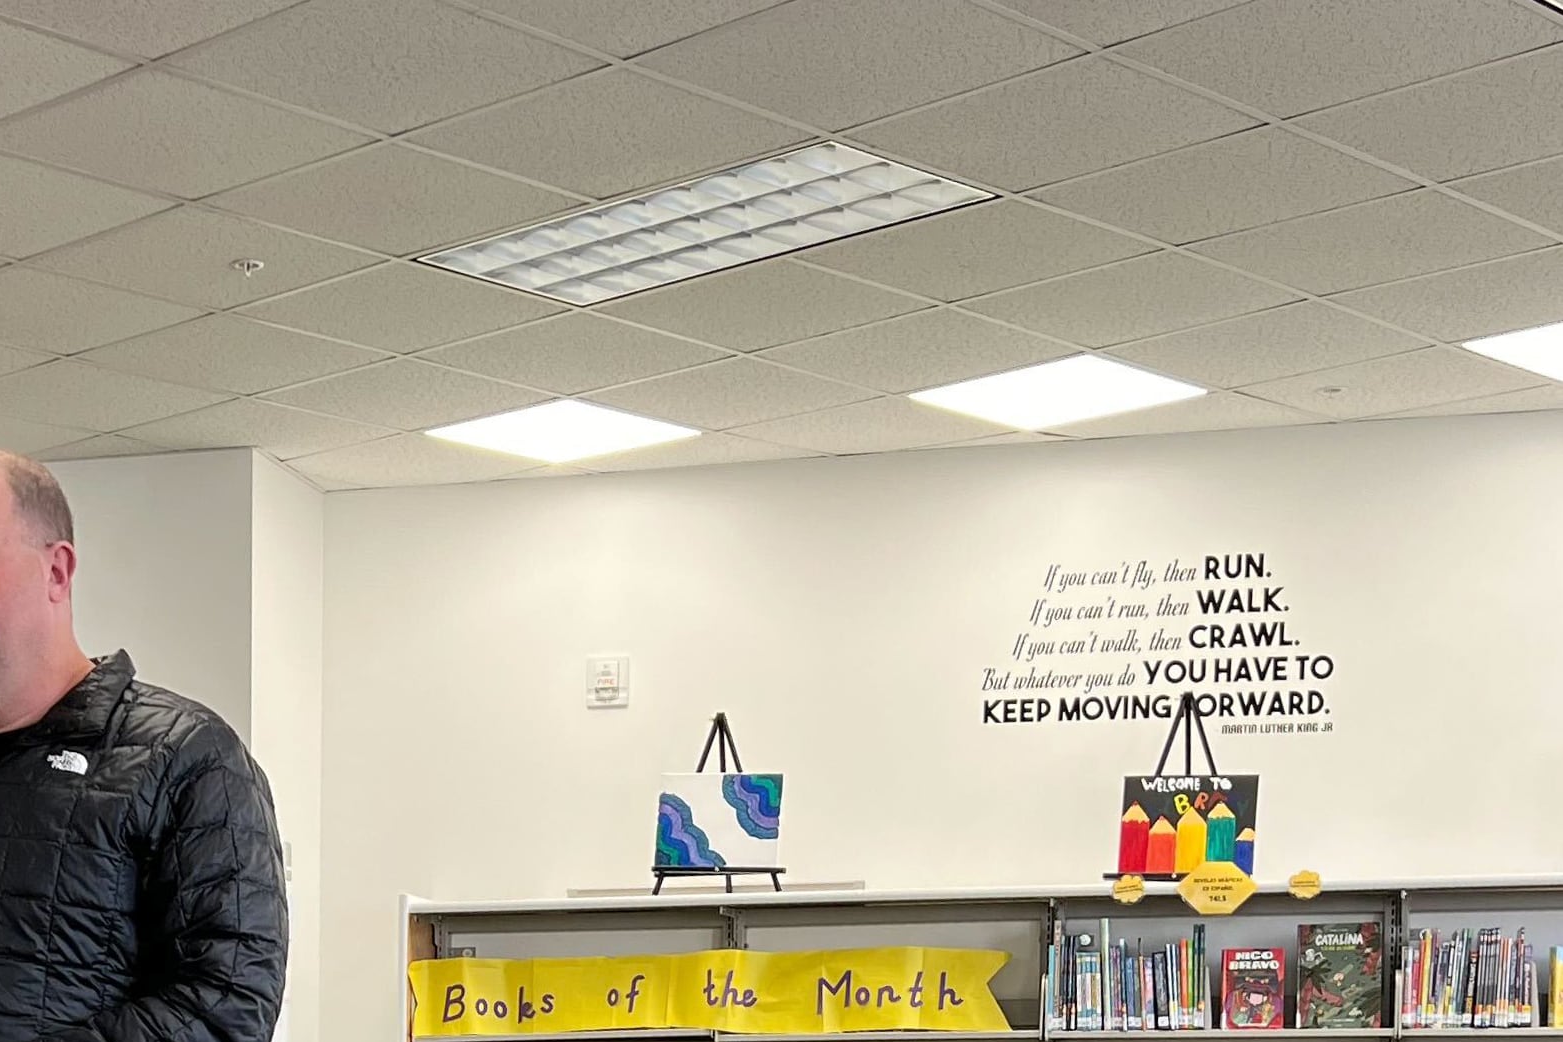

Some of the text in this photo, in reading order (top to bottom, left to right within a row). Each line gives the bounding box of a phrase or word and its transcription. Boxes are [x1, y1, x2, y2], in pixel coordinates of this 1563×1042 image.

[1043, 553, 1272, 593] If you can't fly, then RUN.
[1029, 586, 1289, 628] If you can't run, then WALK.
[1012, 621, 1300, 662] If you can't walk, then CRAWL.
[982, 655, 1334, 694] But whatever you do YOU HAVE TO
[983, 690, 1331, 724] KEEP MOVING ORWARD.
[1221, 724, 1257, 735] MARTIN
[1260, 723, 1294, 734] LUTHER
[1297, 722, 1318, 733] KING
[1141, 777, 1232, 793] WELCOME TO
[1228, 961, 1280, 971] BRAVO
[1235, 951, 1274, 961] NICO
[442, 969, 964, 1024] Books of the Month
